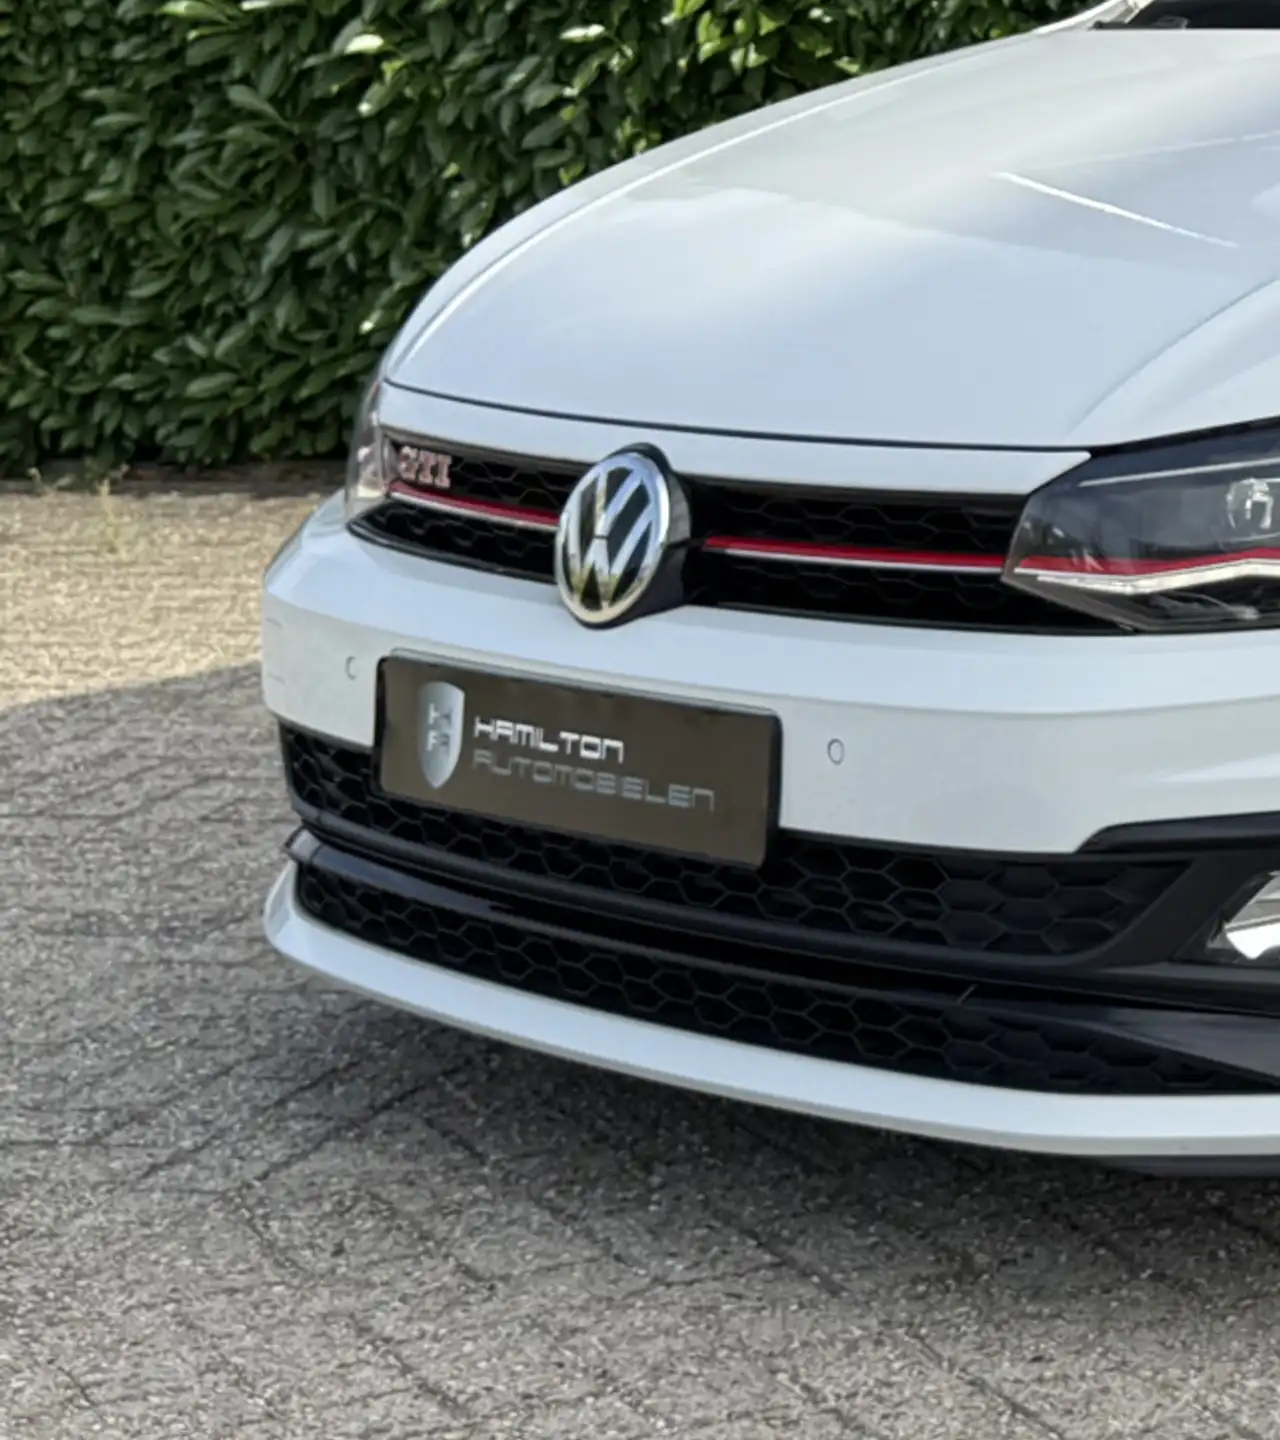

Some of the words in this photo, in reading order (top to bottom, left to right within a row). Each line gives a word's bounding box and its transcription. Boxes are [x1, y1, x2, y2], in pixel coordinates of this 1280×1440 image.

[399, 446, 452, 488] GTI
[473, 716, 625, 764] HAMILTON
[472, 748, 715, 812] AUTOMOBIELEN
